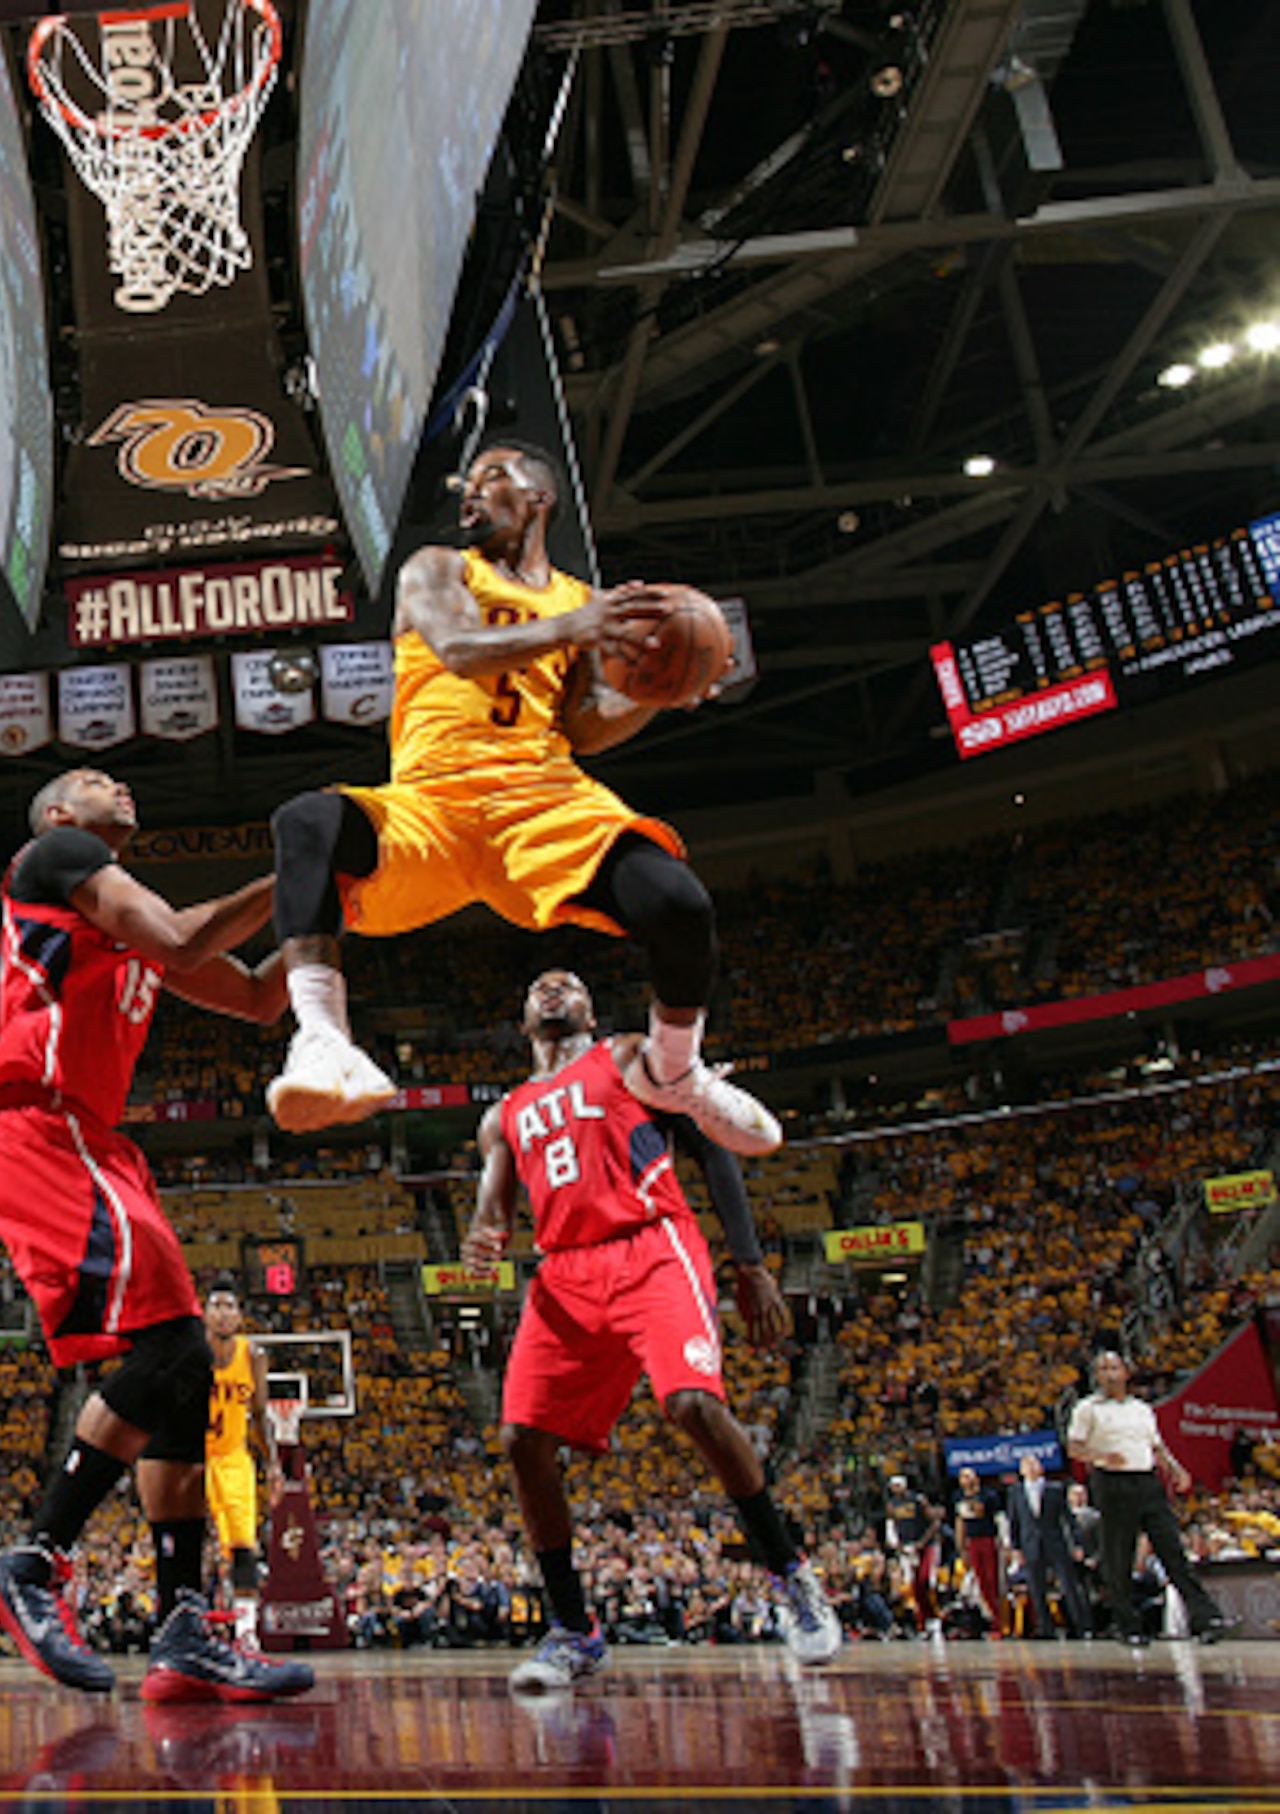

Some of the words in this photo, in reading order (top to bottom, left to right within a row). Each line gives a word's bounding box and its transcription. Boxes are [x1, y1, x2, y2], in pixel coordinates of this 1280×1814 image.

[118, 956, 164, 1024] 15
[516, 1080, 606, 1153] ATL
[544, 1135, 581, 1190] 8
